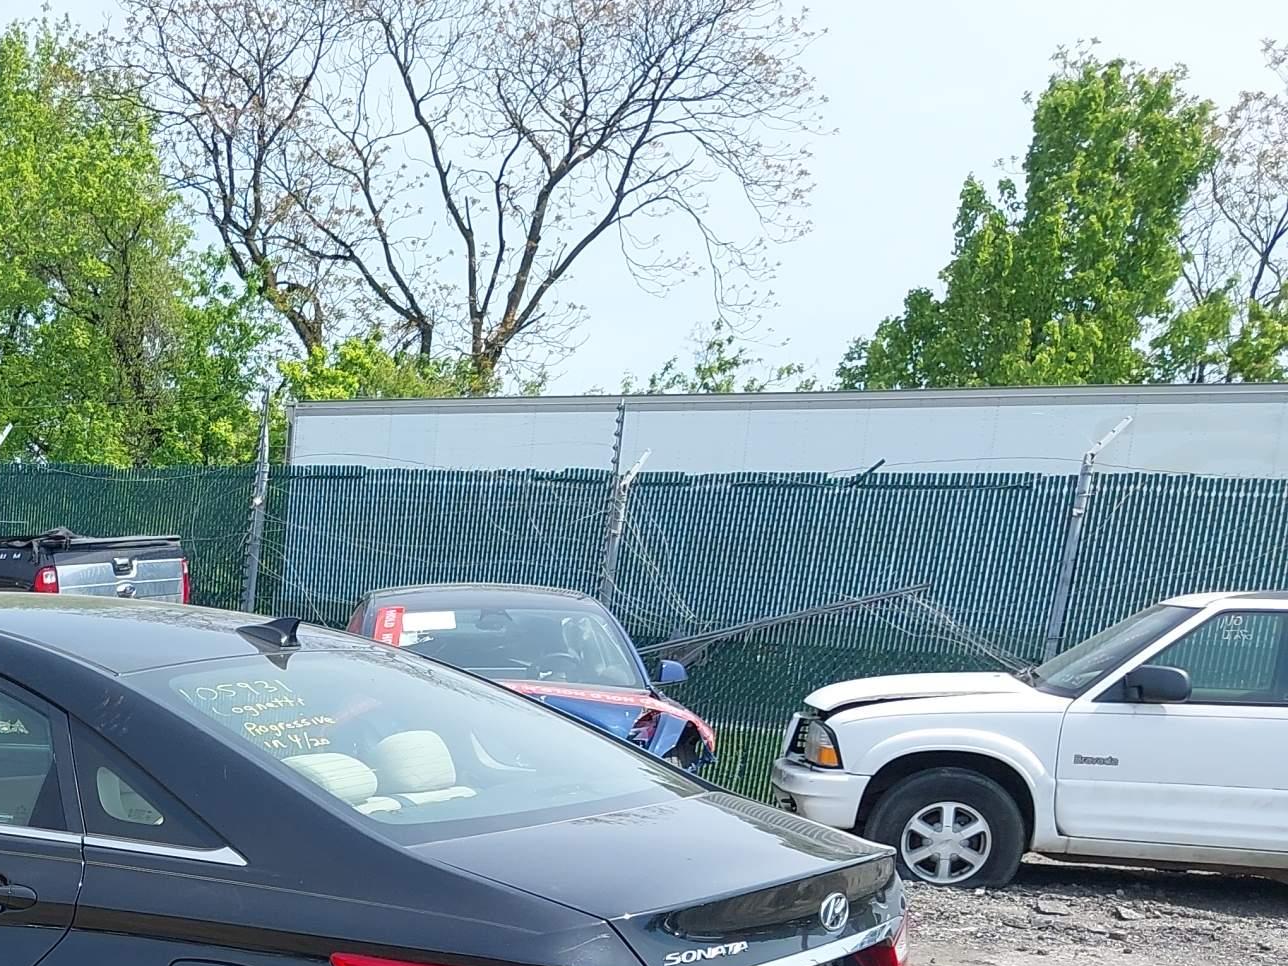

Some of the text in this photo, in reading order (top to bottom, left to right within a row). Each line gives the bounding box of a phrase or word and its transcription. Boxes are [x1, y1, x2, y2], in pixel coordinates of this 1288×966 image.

[179, 679, 293, 702] 105931
[244, 715, 337, 737] Progressive
[663, 940, 749, 966] SONATA
